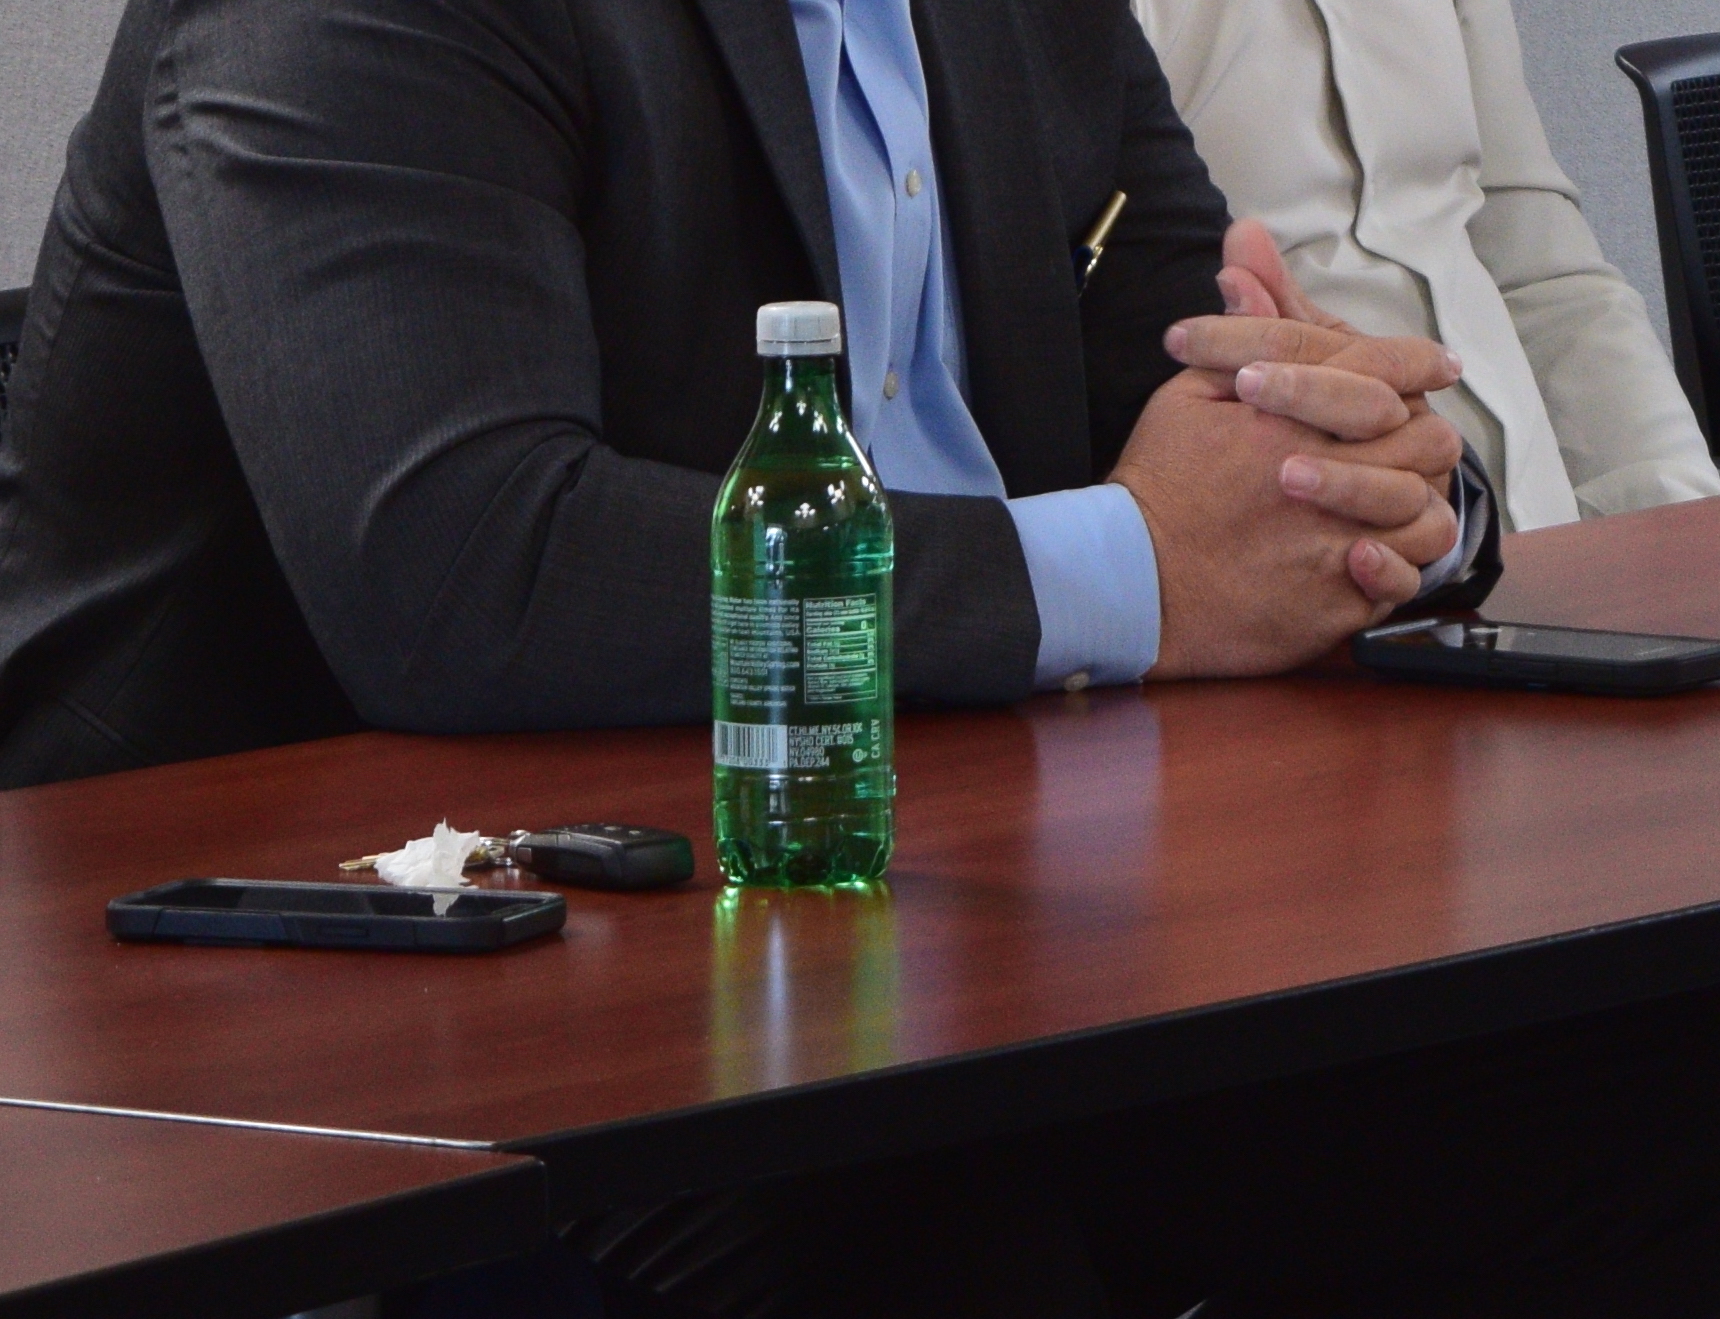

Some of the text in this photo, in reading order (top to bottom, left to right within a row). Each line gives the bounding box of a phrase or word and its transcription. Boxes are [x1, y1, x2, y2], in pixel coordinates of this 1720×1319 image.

[805, 598, 867, 609] Nutrition Facts
[806, 626, 841, 635] Calories
[871, 719, 880, 759] CA CRV
